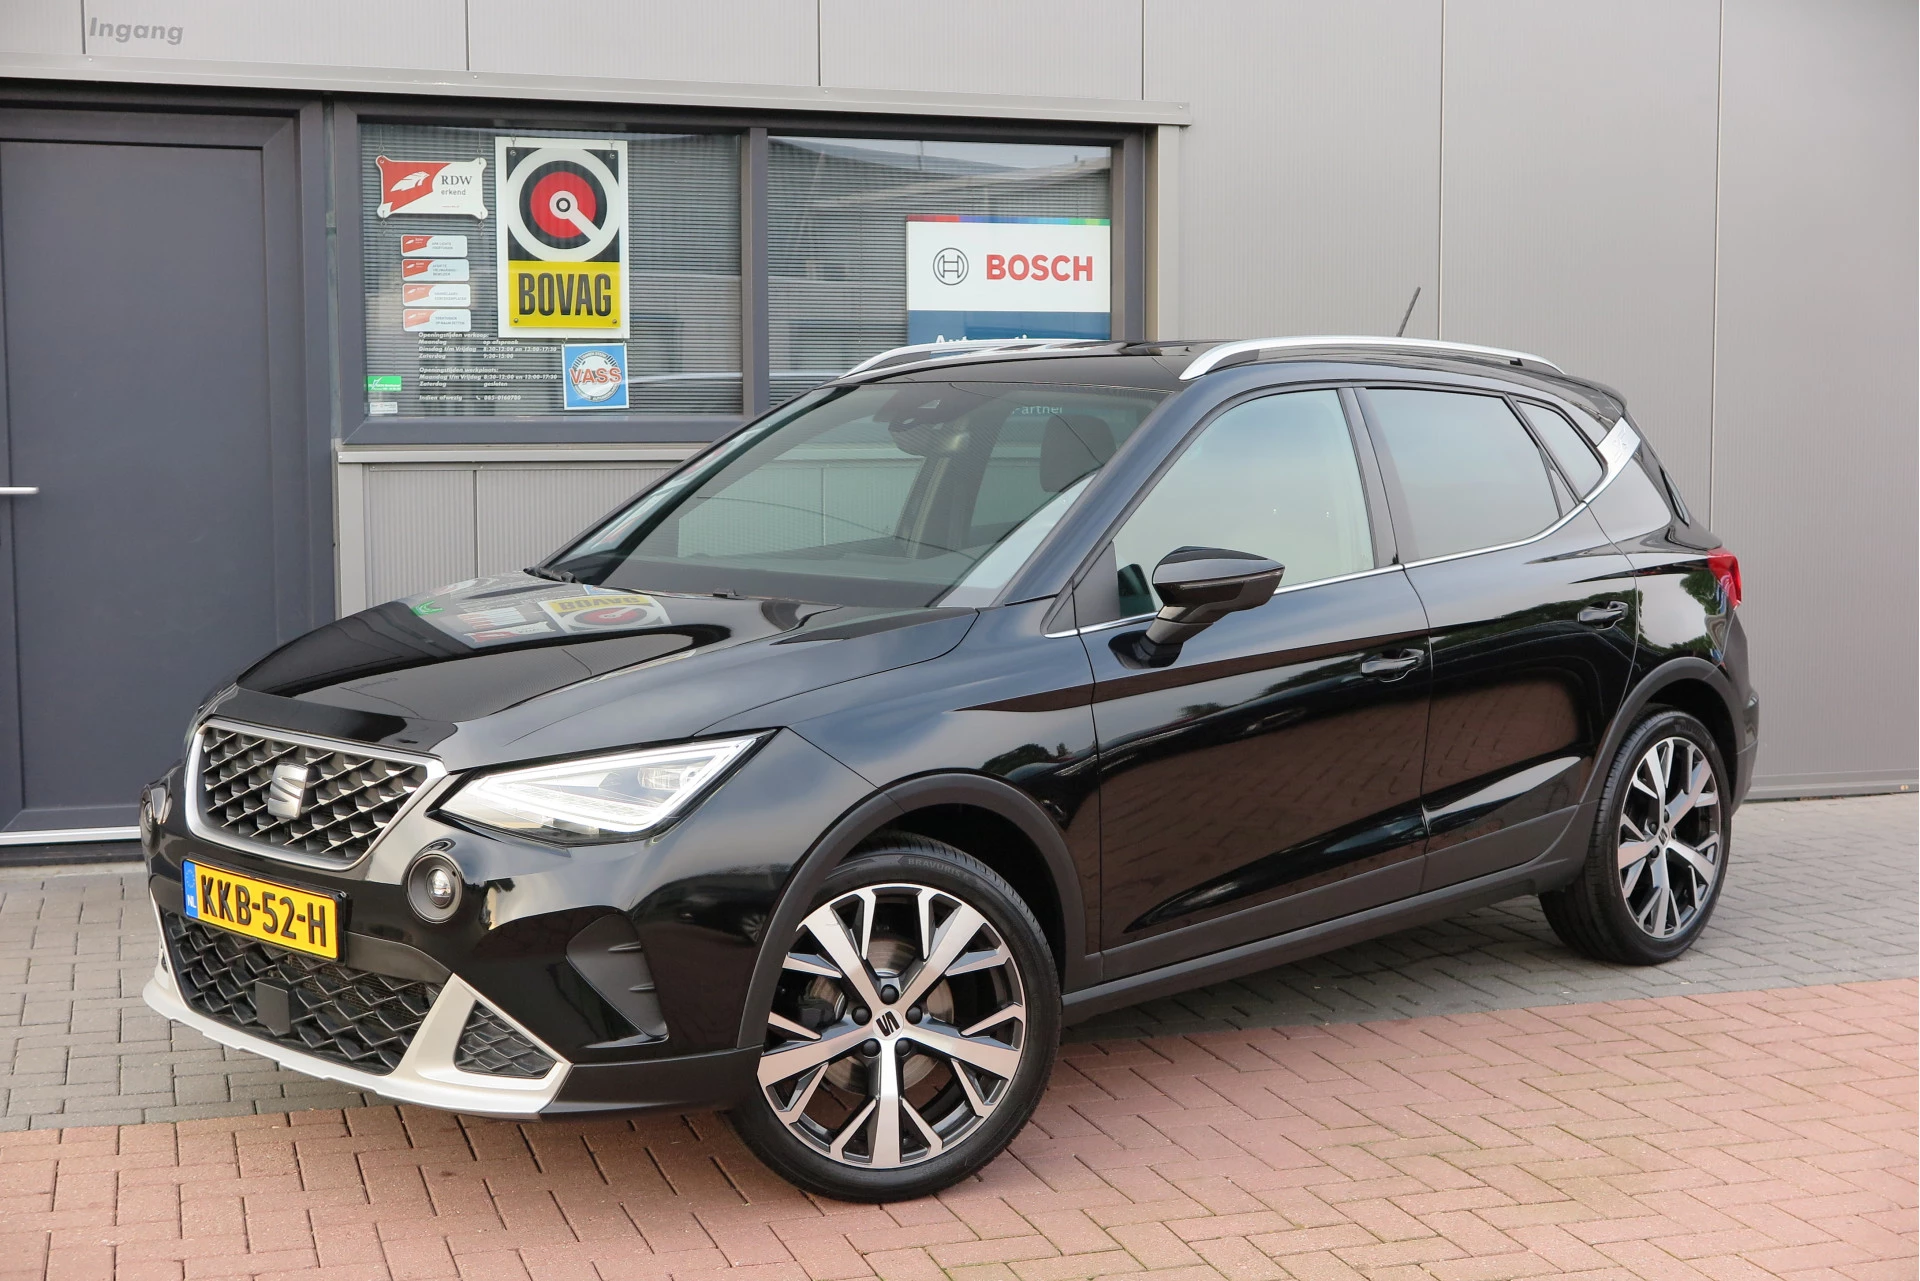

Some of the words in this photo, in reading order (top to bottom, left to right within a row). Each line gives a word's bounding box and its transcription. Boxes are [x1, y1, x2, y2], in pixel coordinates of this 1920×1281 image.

[89, 17, 184, 45] Ingang
[441, 175, 473, 186] RDW
[986, 254, 1093, 281] BOSCH
[518, 272, 612, 317] BOVAG
[418, 332, 463, 340] Openingstijden
[570, 367, 622, 384] VASS
[1011, 406, 1063, 415] artner
[908, 858, 962, 878] BRAVURIS
[186, 894, 197, 909] NL
[200, 874, 327, 947] KKB-52-H
